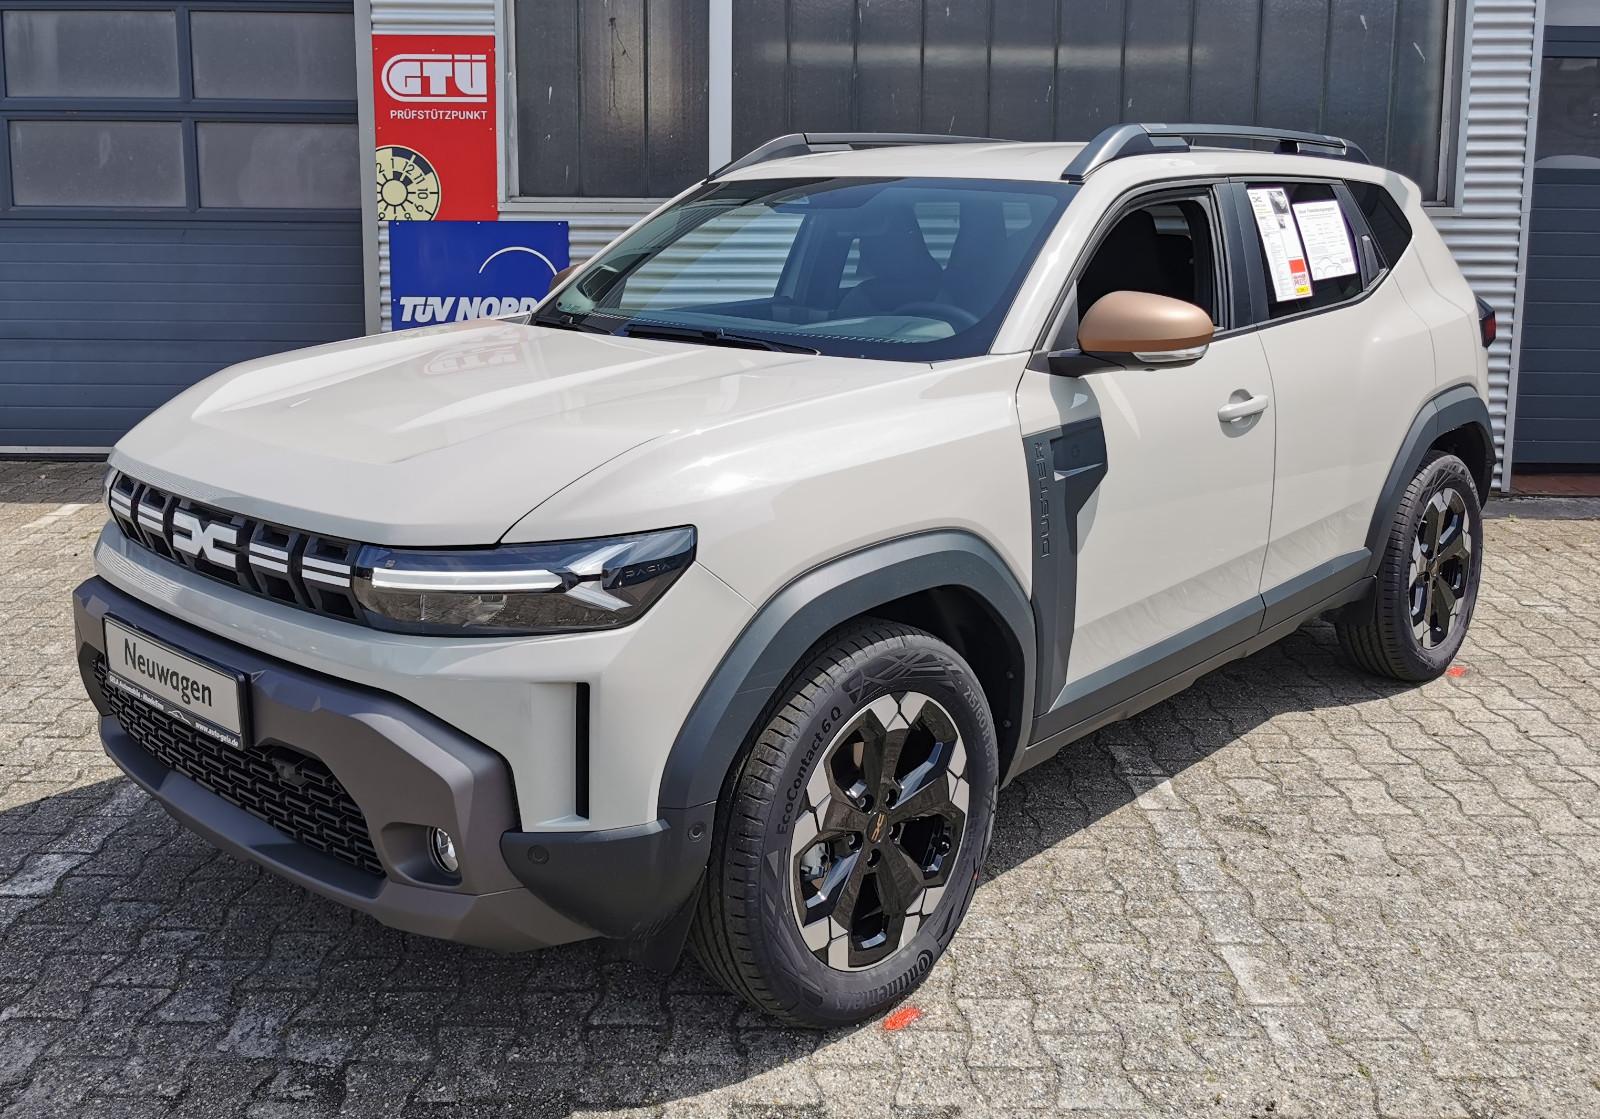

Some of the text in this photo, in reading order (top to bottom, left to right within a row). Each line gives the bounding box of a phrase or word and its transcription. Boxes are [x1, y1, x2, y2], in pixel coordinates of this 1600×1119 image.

[384, 54, 487, 98] GTÜ
[390, 108, 487, 120] PRÜFSTÜTZPUNKT
[402, 161, 415, 175] 12
[417, 188, 429, 200] 10
[400, 296, 539, 323] TÜV NORD
[1034, 442, 1051, 558] DUSTER
[625, 563, 671, 578] DACIA
[124, 638, 212, 707] Neuwagen
[776, 732, 823, 836] EcoContact
[822, 718, 832, 734] 6
